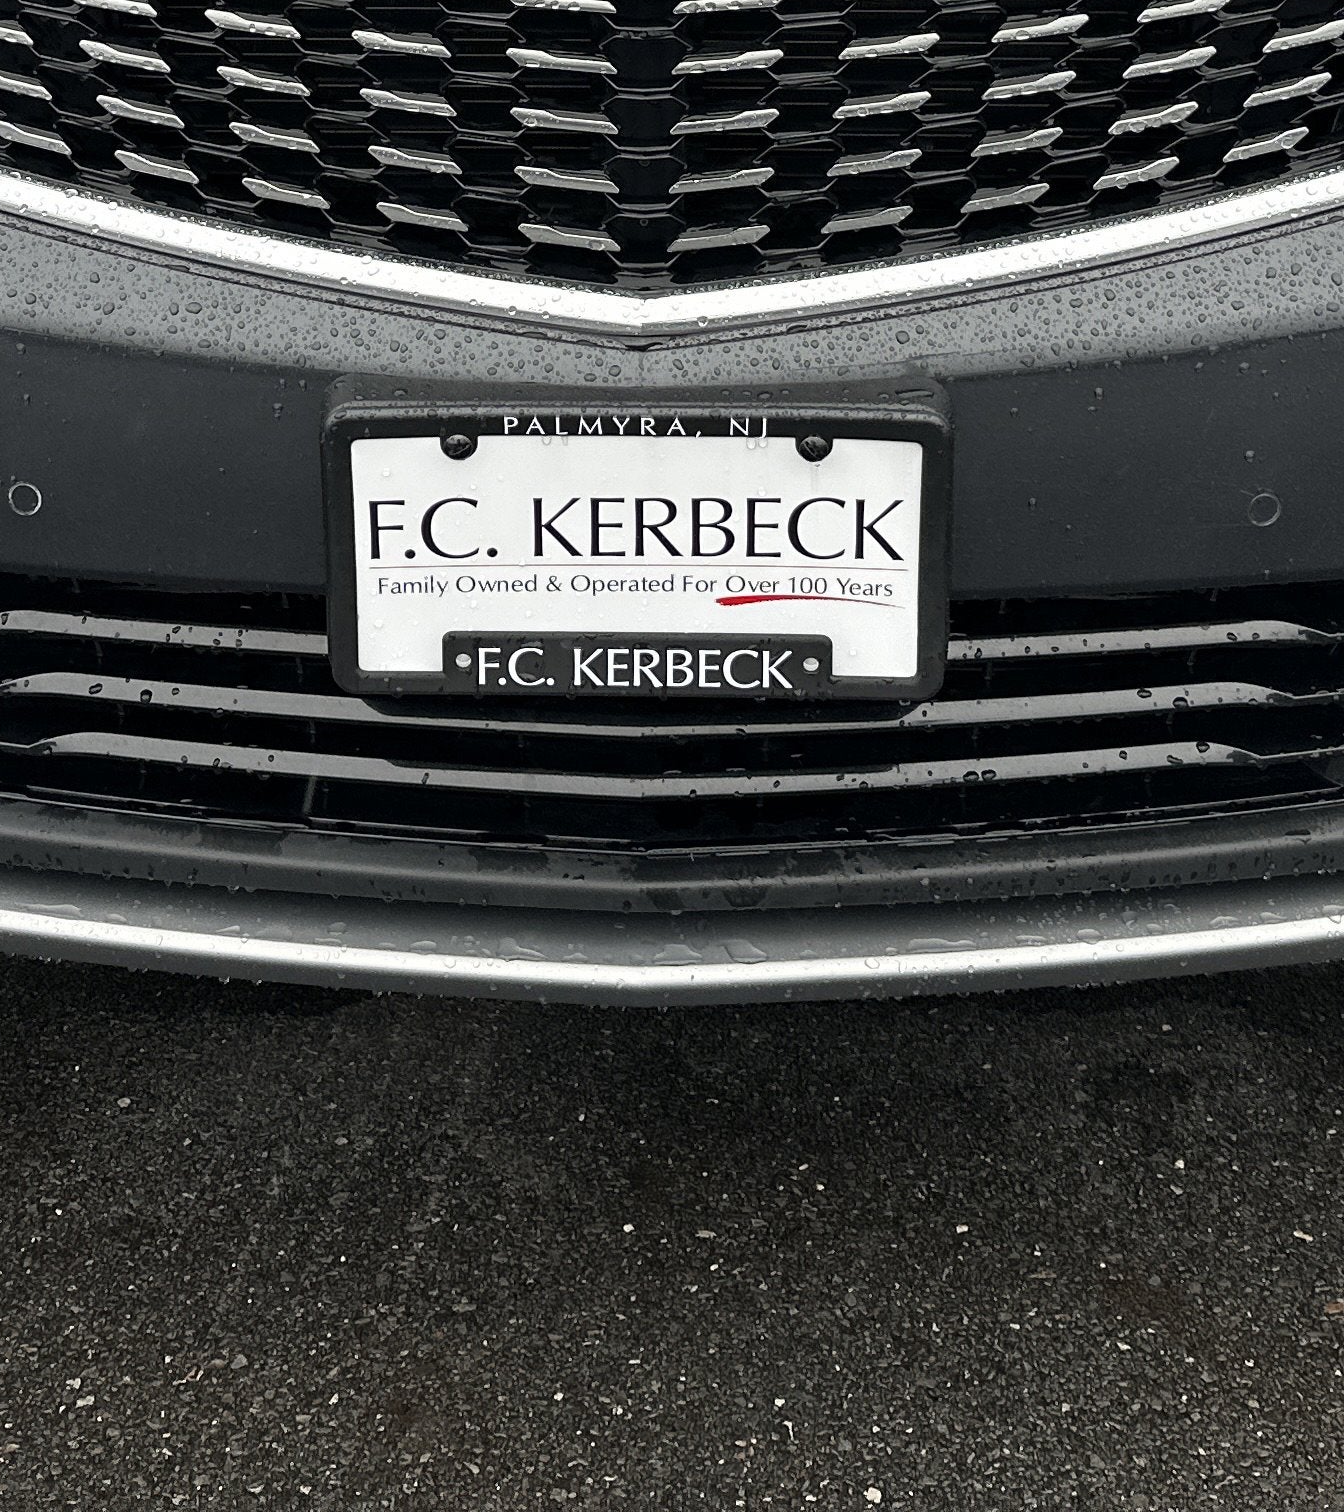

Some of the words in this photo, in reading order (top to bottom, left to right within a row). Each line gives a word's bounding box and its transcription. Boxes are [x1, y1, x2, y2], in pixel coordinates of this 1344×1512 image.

[503, 416, 703, 438] PALMYRA,
[729, 417, 768, 439] NJ
[369, 497, 498, 560] F.C.
[532, 497, 905, 561] KERBECK
[378, 575, 448, 597] Family
[456, 574, 538, 593] Owned
[546, 575, 562, 593] &
[570, 574, 675, 597] Operated
[683, 575, 718, 593] For
[726, 575, 780, 594] Over
[788, 576, 828, 595] 100
[836, 577, 894, 597] Years
[478, 647, 555, 686] F.C.
[573, 648, 794, 689] KERBECK
